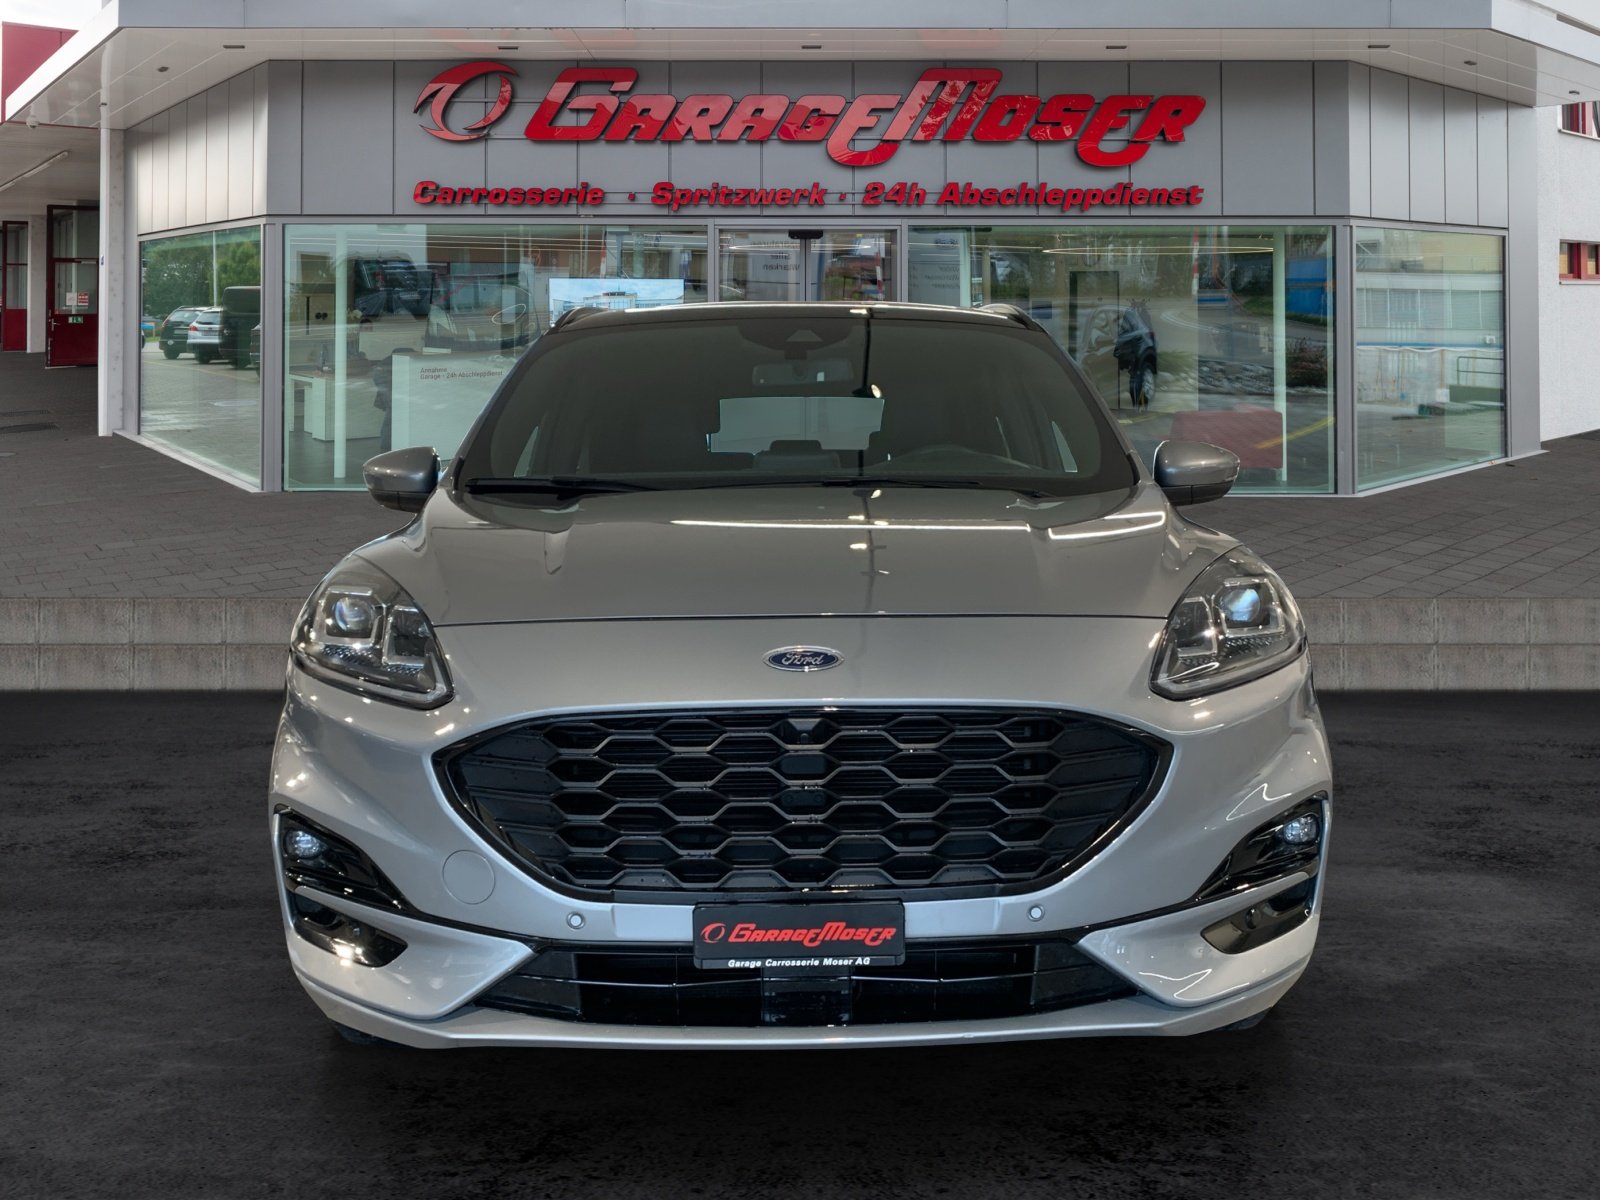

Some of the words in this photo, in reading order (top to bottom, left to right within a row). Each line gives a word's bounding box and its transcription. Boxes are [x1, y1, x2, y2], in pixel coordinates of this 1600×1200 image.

[413, 181, 604, 206] Carrosserie
[651, 182, 826, 211] Spritzwerk
[862, 182, 926, 205] 24h
[937, 182, 1203, 211] Abschleppdienst
[781, 651, 824, 665] Ford
[728, 959, 762, 968] Garage
[765, 958, 819, 967] Carrosserie
[823, 957, 852, 966] Moser
[855, 957, 870, 965] AG
